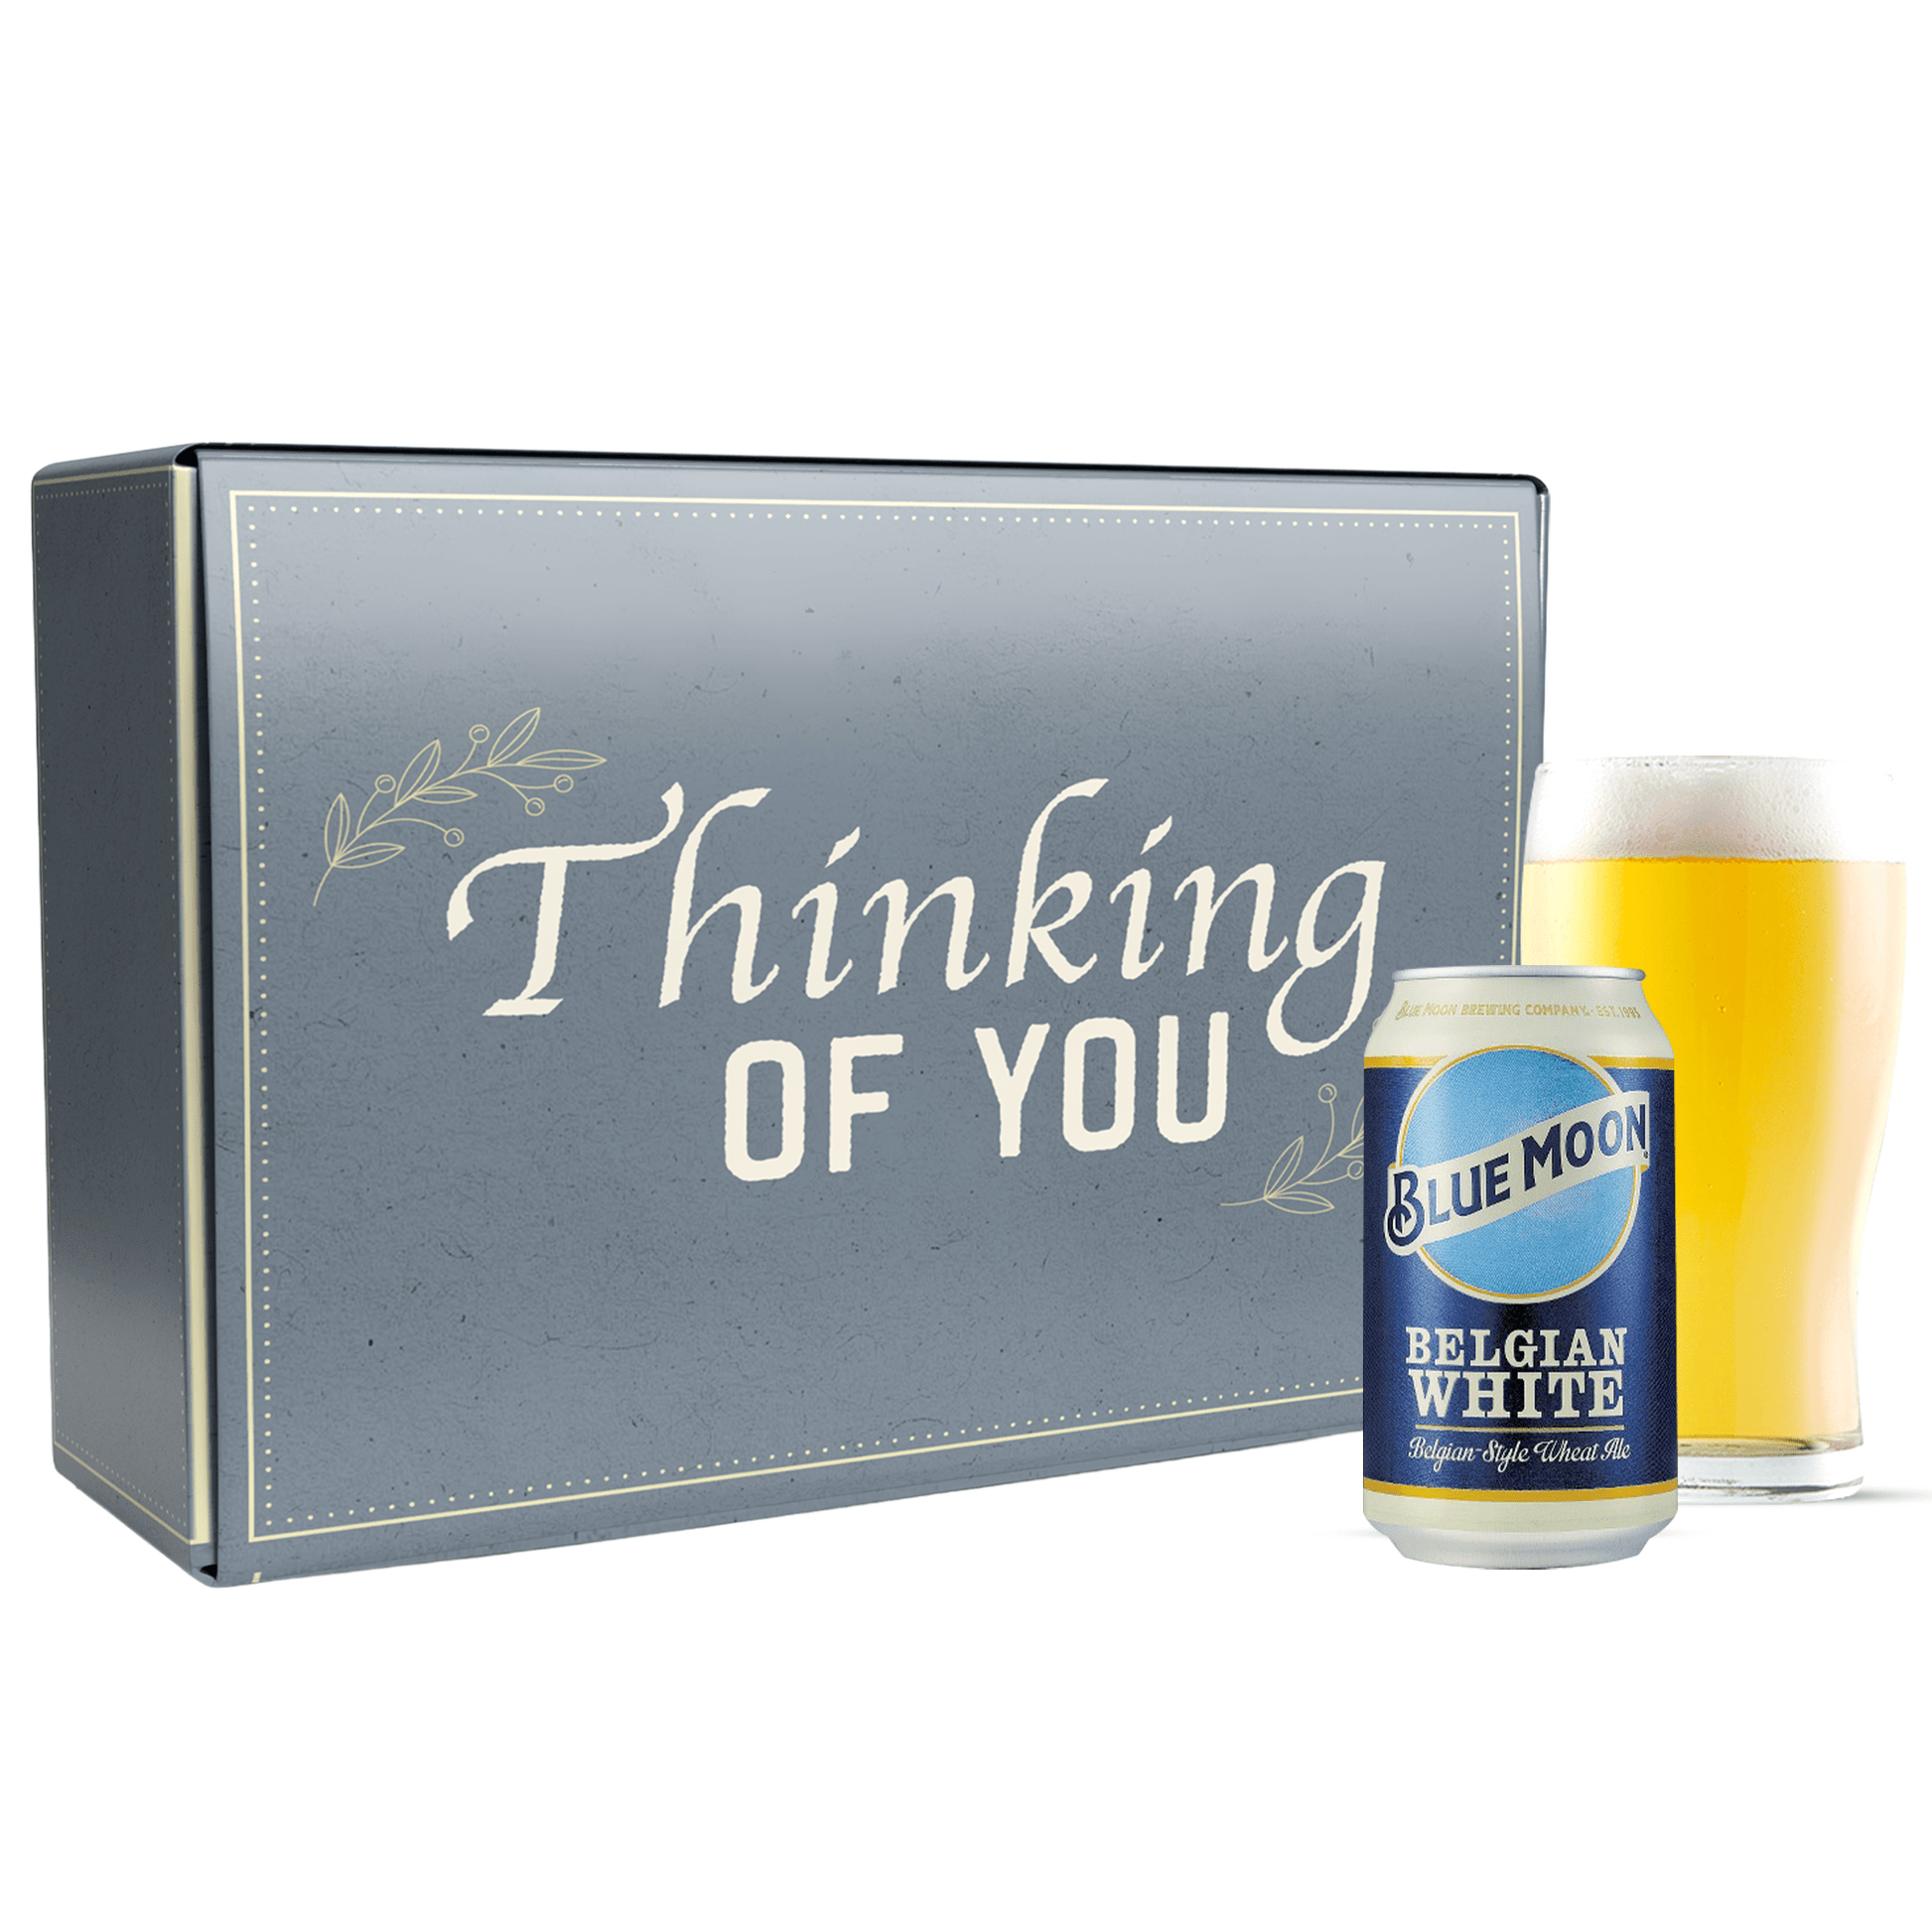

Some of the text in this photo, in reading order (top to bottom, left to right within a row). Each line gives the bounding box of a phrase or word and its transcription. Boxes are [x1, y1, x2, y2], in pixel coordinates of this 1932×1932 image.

[447, 778, 1387, 1057] Thinking
[1460, 1004, 1521, 1016] BREWING
[725, 1012, 1229, 1181] OF YOU
[1388, 1153, 1511, 1246] BLUE
[1406, 1326, 1627, 1367] BELGIAN
[1408, 1369, 1623, 1419] WHITE
[1408, 1437, 1631, 1472] Belgian-Style Wheat Ale
